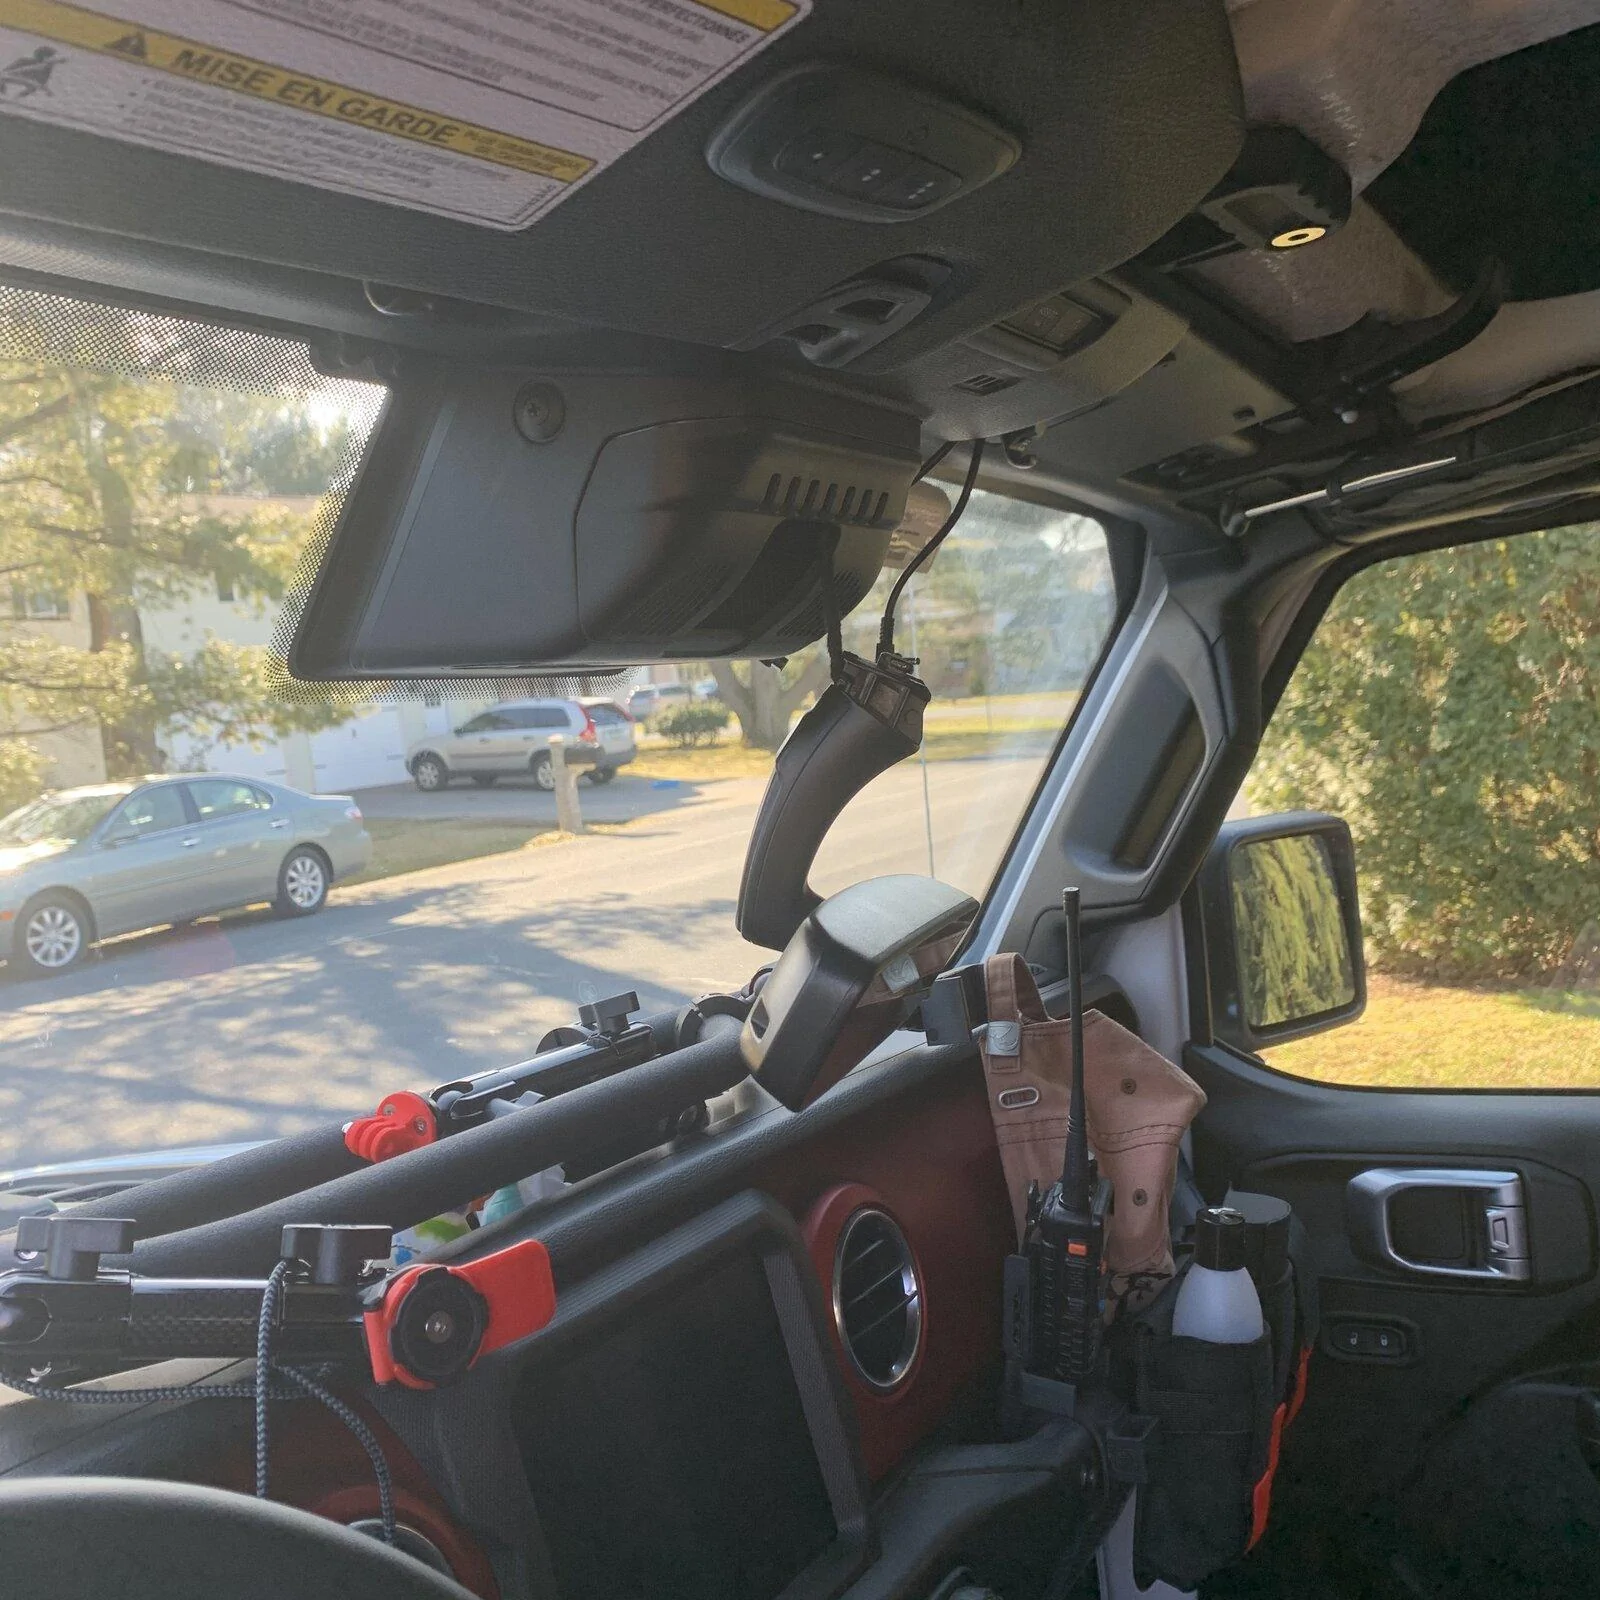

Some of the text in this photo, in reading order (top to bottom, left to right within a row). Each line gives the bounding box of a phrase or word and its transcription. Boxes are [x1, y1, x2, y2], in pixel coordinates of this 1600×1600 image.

[173, 50, 274, 90] MISE
[277, 79, 336, 107] EN
[338, 100, 460, 143] GARDE
